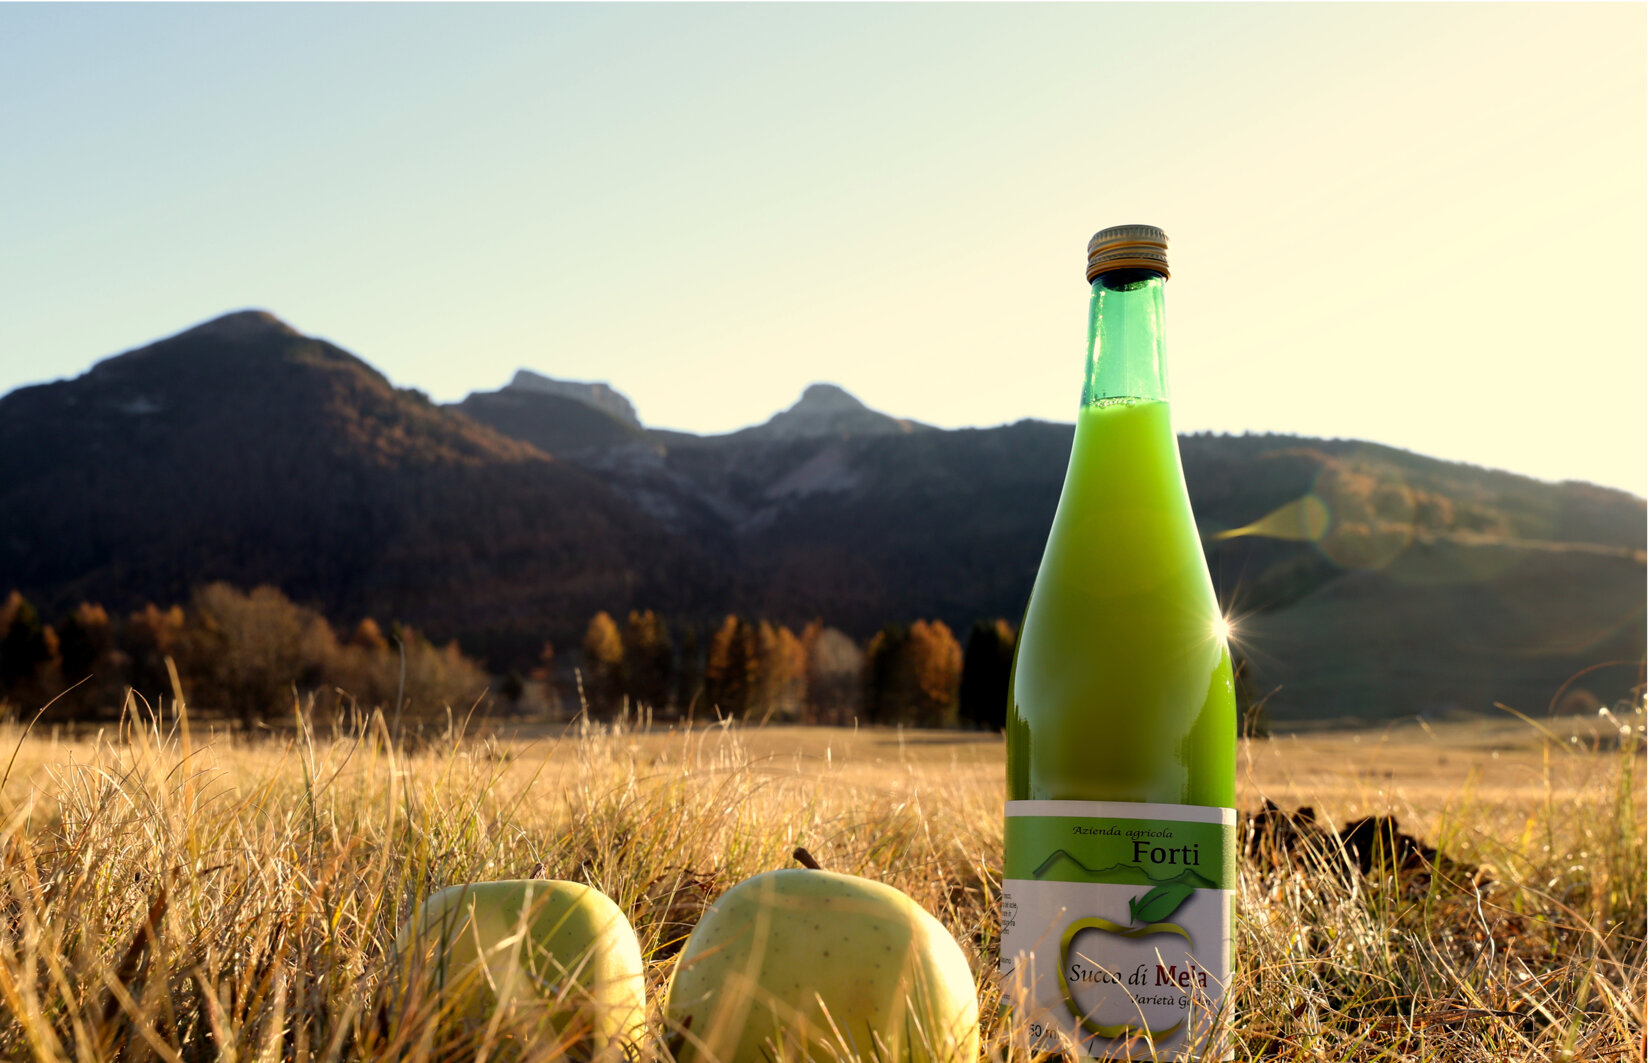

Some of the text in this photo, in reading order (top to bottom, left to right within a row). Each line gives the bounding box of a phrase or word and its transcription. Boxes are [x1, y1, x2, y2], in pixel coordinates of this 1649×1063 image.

[1072, 825, 1173, 840] Azienda agricola
[1131, 840, 1200, 866] Forti
[1069, 964, 1208, 988] Succo di Mela
[1178, 994, 1211, 1009] Gon
